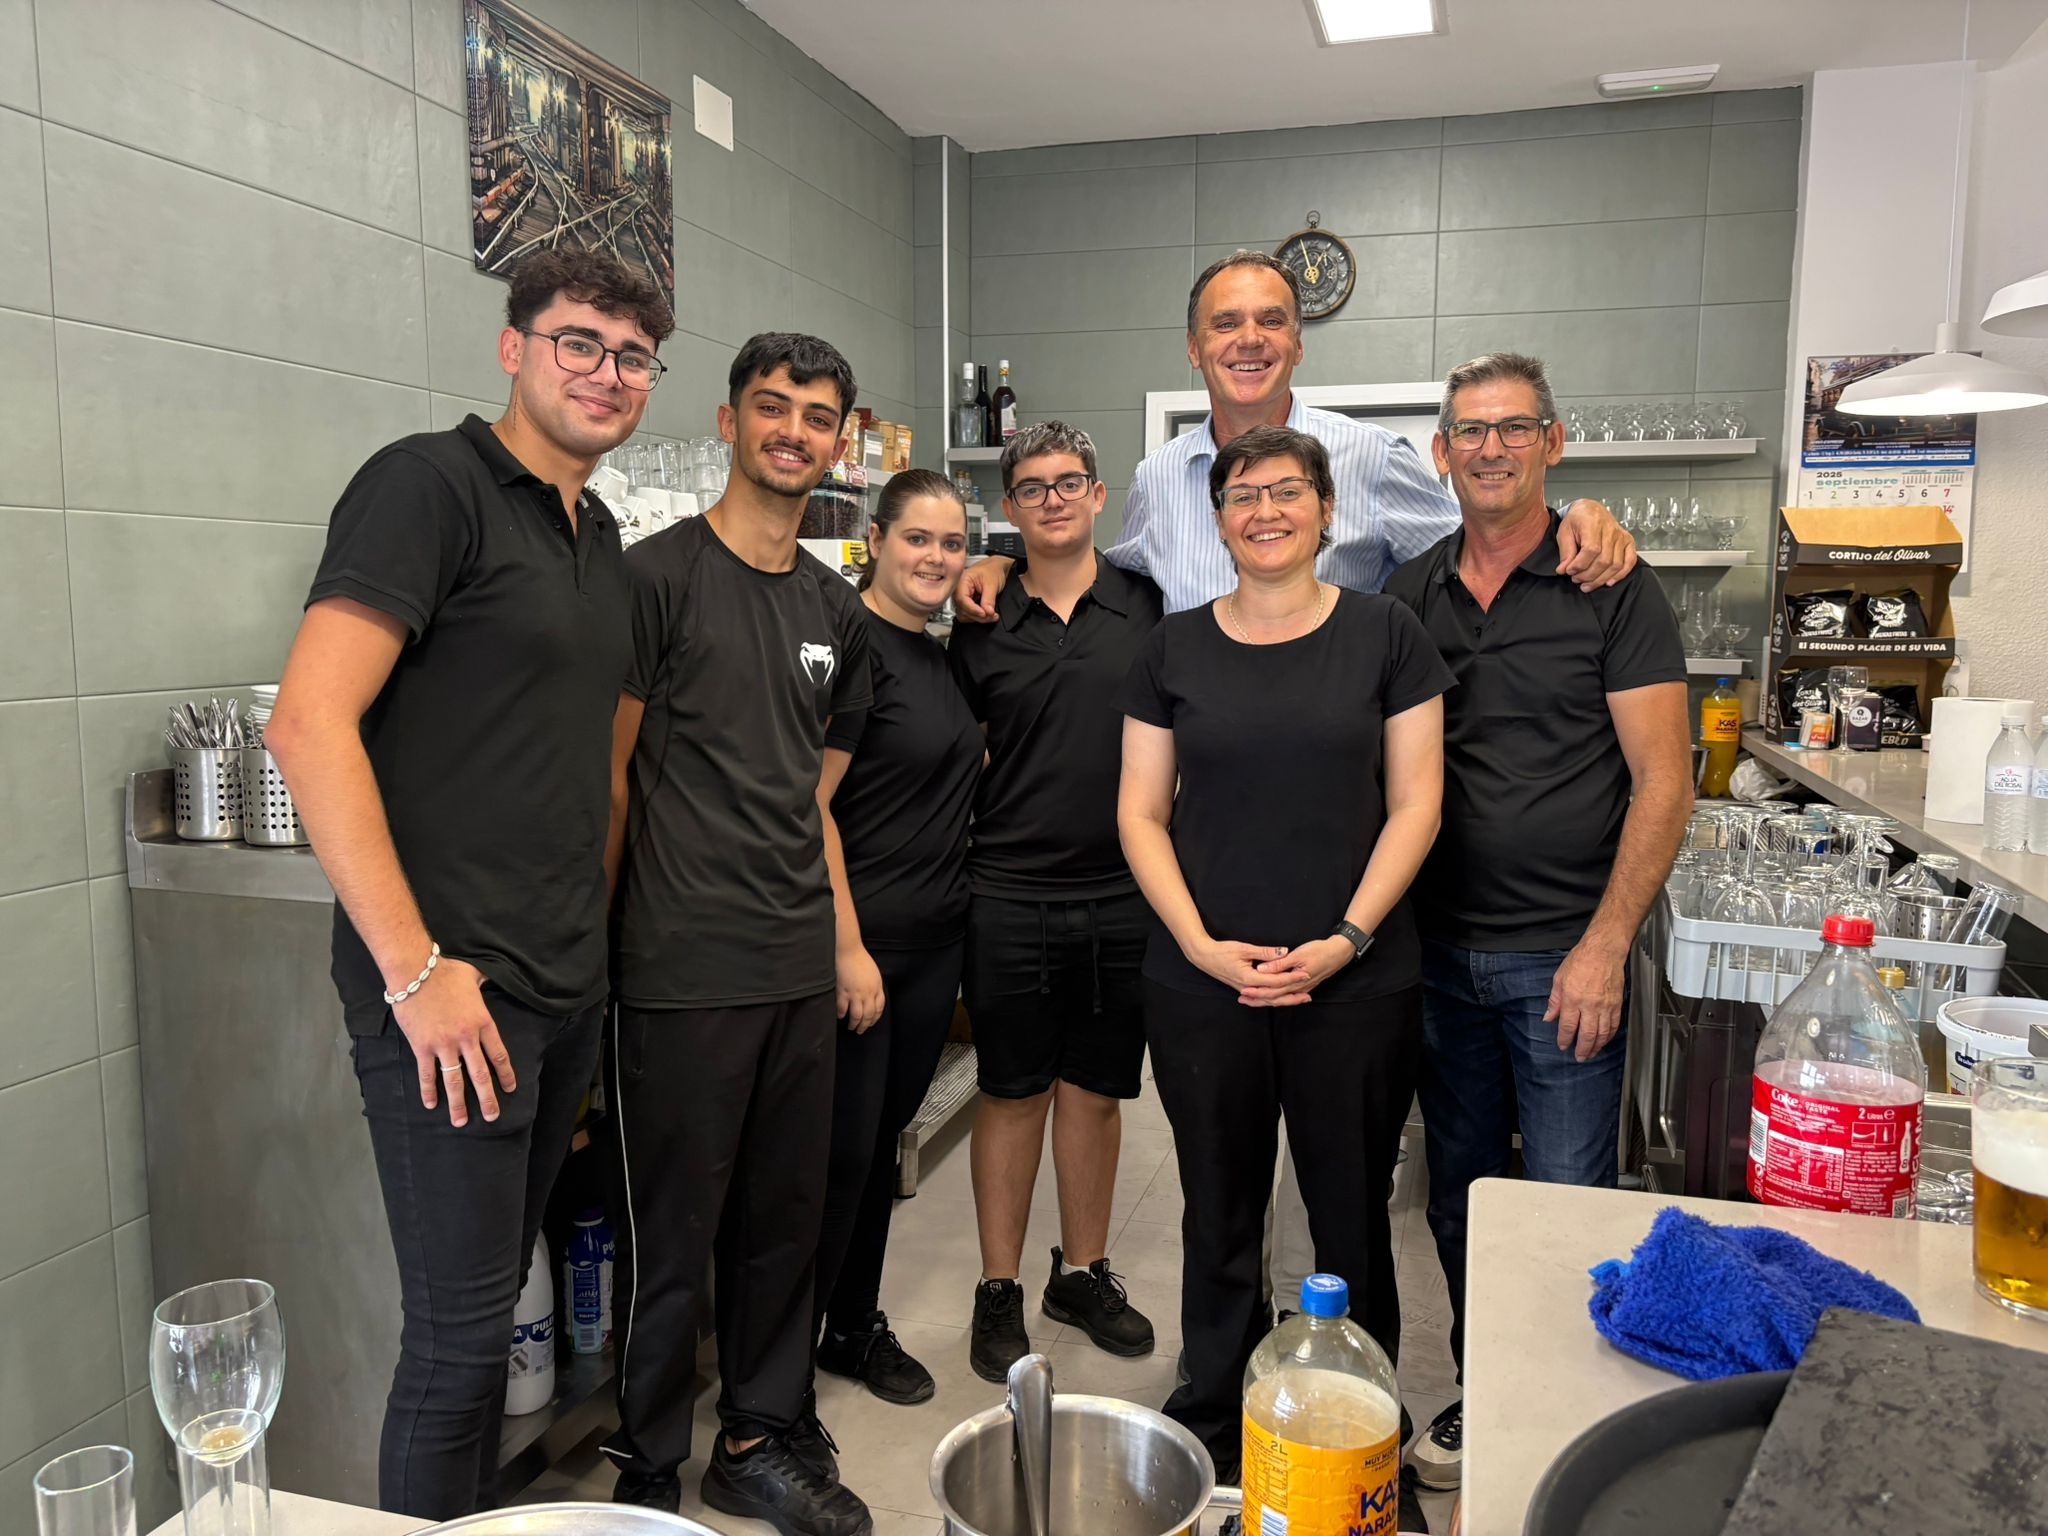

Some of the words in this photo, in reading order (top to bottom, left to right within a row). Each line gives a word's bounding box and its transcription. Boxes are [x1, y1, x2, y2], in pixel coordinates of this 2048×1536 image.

[1816, 477, 1899, 487] septiembre
[1830, 490, 1837, 499] 2
[1852, 490, 1860, 499] 3
[1875, 489, 1883, 498] 4
[1898, 489, 1905, 498] 5
[1921, 488, 1928, 498] 6
[1943, 488, 1951, 498] 7
[1828, 551, 1873, 561] CORTIJO
[1873, 550, 1893, 561] del
[1893, 548, 1931, 561] Olivar
[1809, 642, 1856, 651] SEGUNDO
[1857, 644, 1892, 652] PLACER
[1894, 644, 1906, 652] DE
[1908, 644, 1921, 652] SU
[1923, 643, 1947, 651] VIDA
[1719, 719, 1737, 727] KAS
[1881, 735, 1909, 746] EBLO
[1771, 1088, 1799, 1107] Coke
[1805, 1101, 1841, 1113] ORIGINAL
[1858, 1107, 1866, 1120] 2
[532, 1316, 553, 1335] PULE
[1270, 1440, 1288, 1456] 2L
[1360, 1478, 1397, 1520] KA
